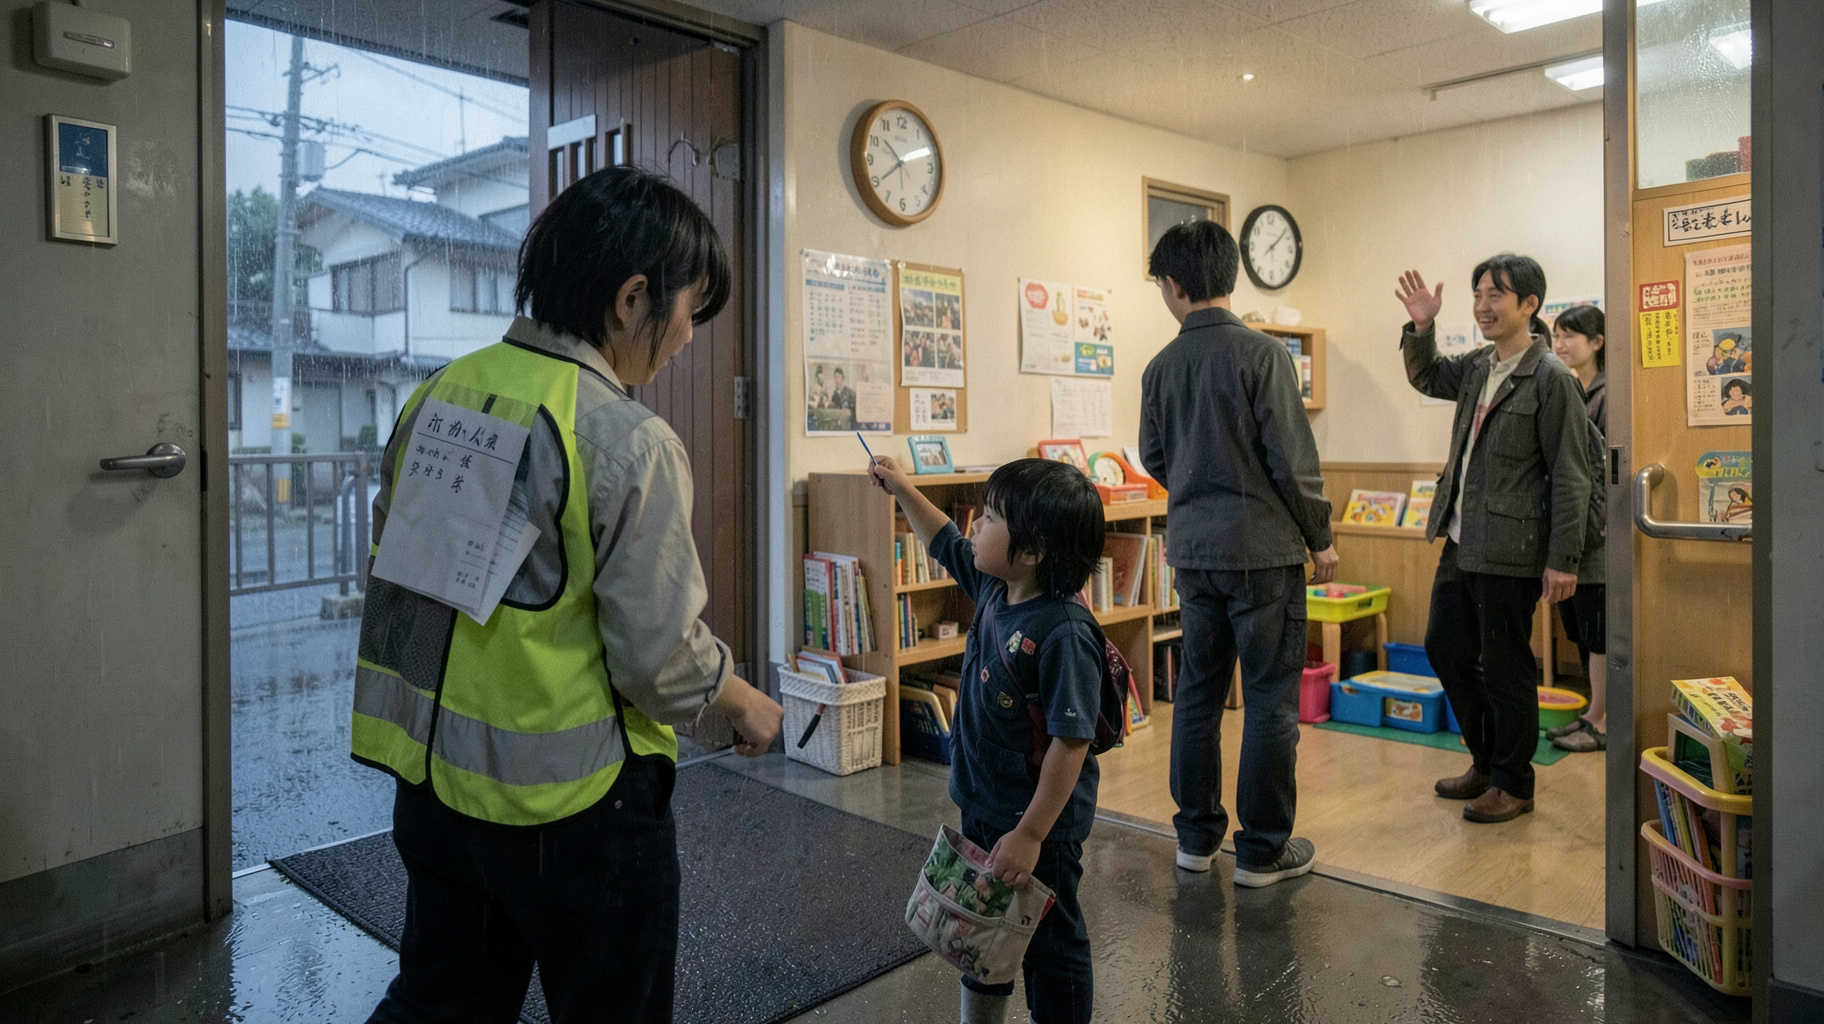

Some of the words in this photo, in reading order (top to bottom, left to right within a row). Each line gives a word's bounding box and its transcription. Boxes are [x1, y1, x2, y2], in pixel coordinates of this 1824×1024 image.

[897, 117, 907, 129] 12
[869, 135, 879, 147] 10
[899, 198, 906, 211] 6
